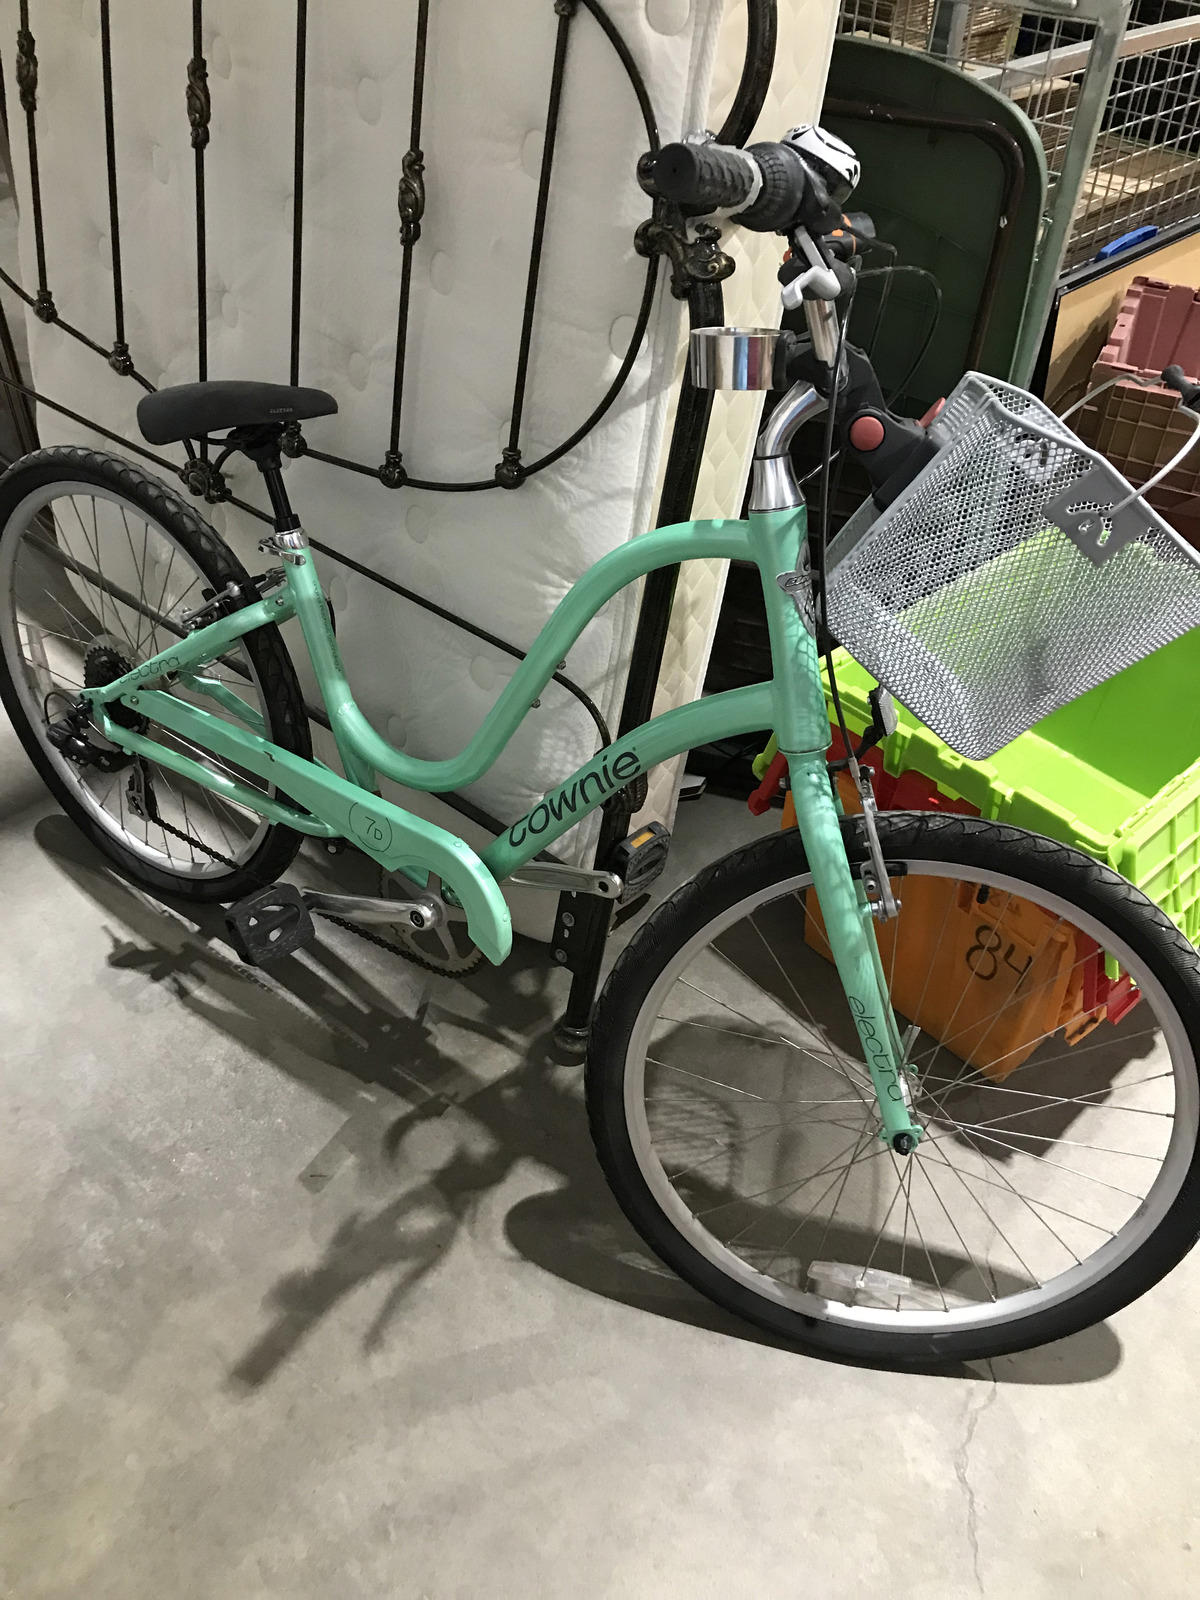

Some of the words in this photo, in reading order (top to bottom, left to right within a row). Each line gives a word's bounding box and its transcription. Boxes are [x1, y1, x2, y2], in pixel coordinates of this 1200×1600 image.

[364, 815, 383, 841] 7D
[509, 751, 641, 847] townie
[965, 924, 1033, 996] 84
[848, 995, 903, 1102] electra
